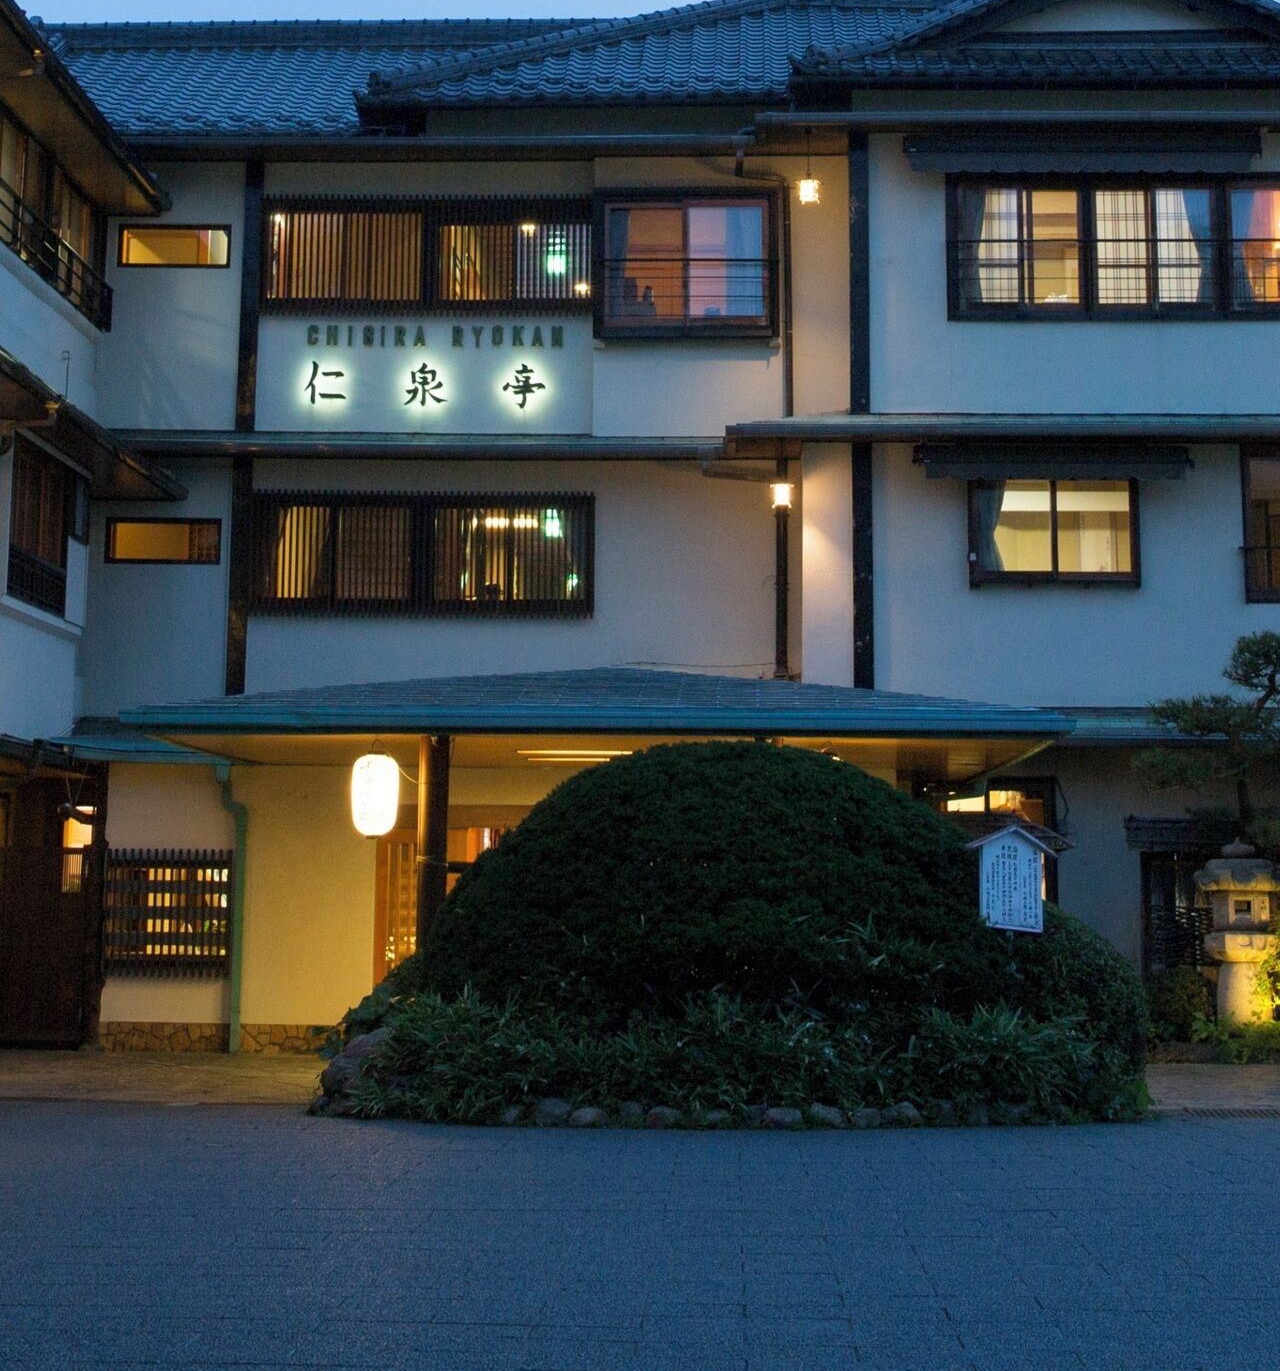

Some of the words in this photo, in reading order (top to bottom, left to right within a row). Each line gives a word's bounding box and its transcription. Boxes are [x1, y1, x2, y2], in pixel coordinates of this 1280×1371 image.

[306, 324, 426, 347] CHIGIRA
[451, 324, 564, 348] RYOKAN
[304, 360, 546, 409] 仁泉亭
